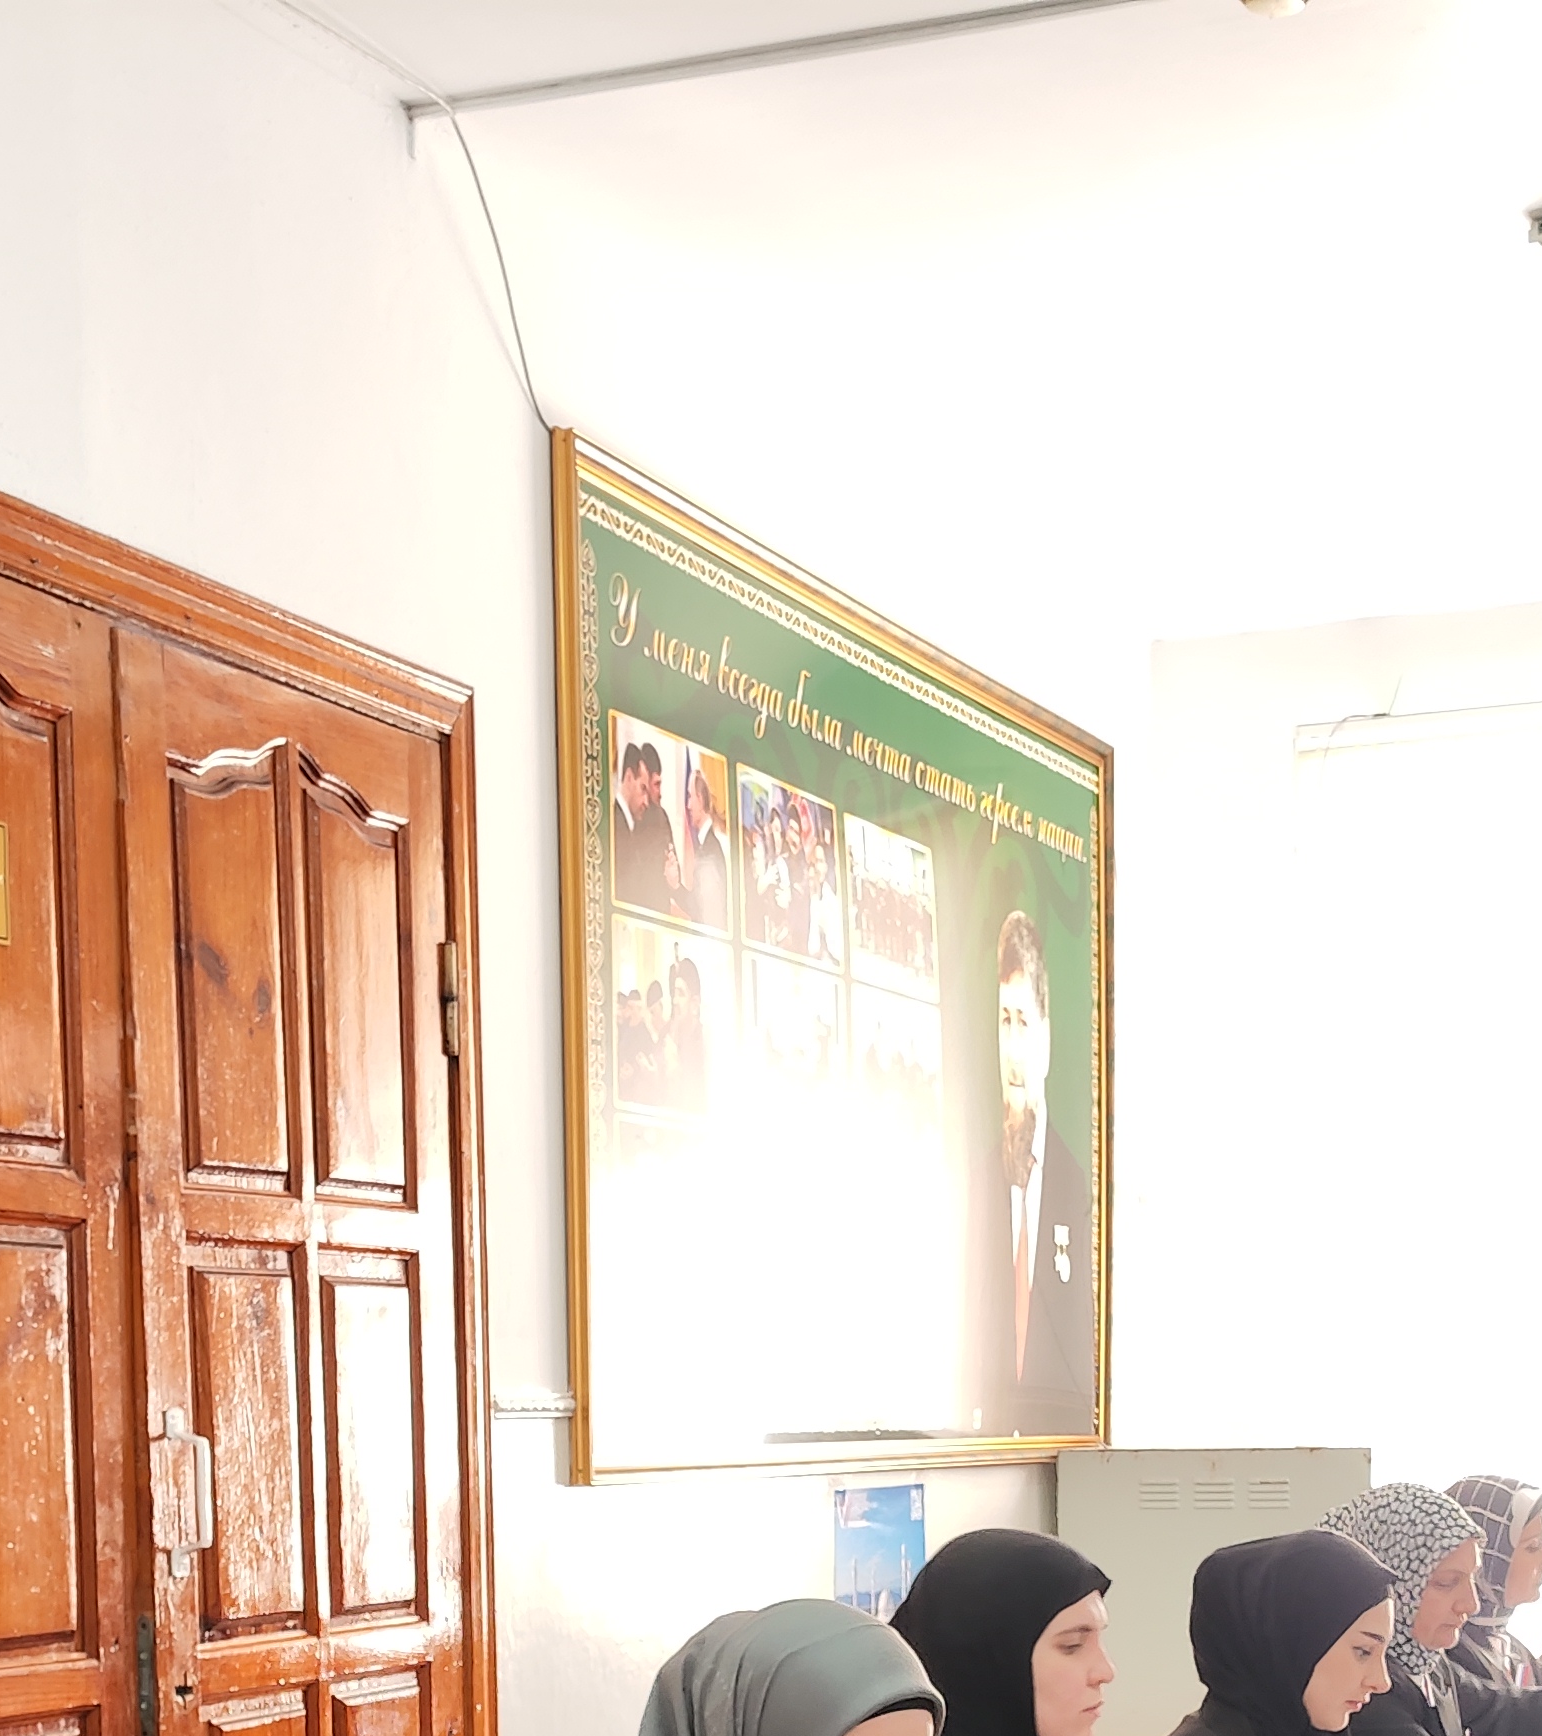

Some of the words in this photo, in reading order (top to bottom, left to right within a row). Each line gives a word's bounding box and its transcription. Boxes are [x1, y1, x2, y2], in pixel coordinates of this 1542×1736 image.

[608, 572, 639, 648] У
[644, 628, 711, 684] меня
[718, 635, 785, 739] всегда
[787, 671, 843, 751] была
[846, 728, 913, 783] мечта
[915, 762, 976, 809] стать
[979, 770, 1034, 844] героем
